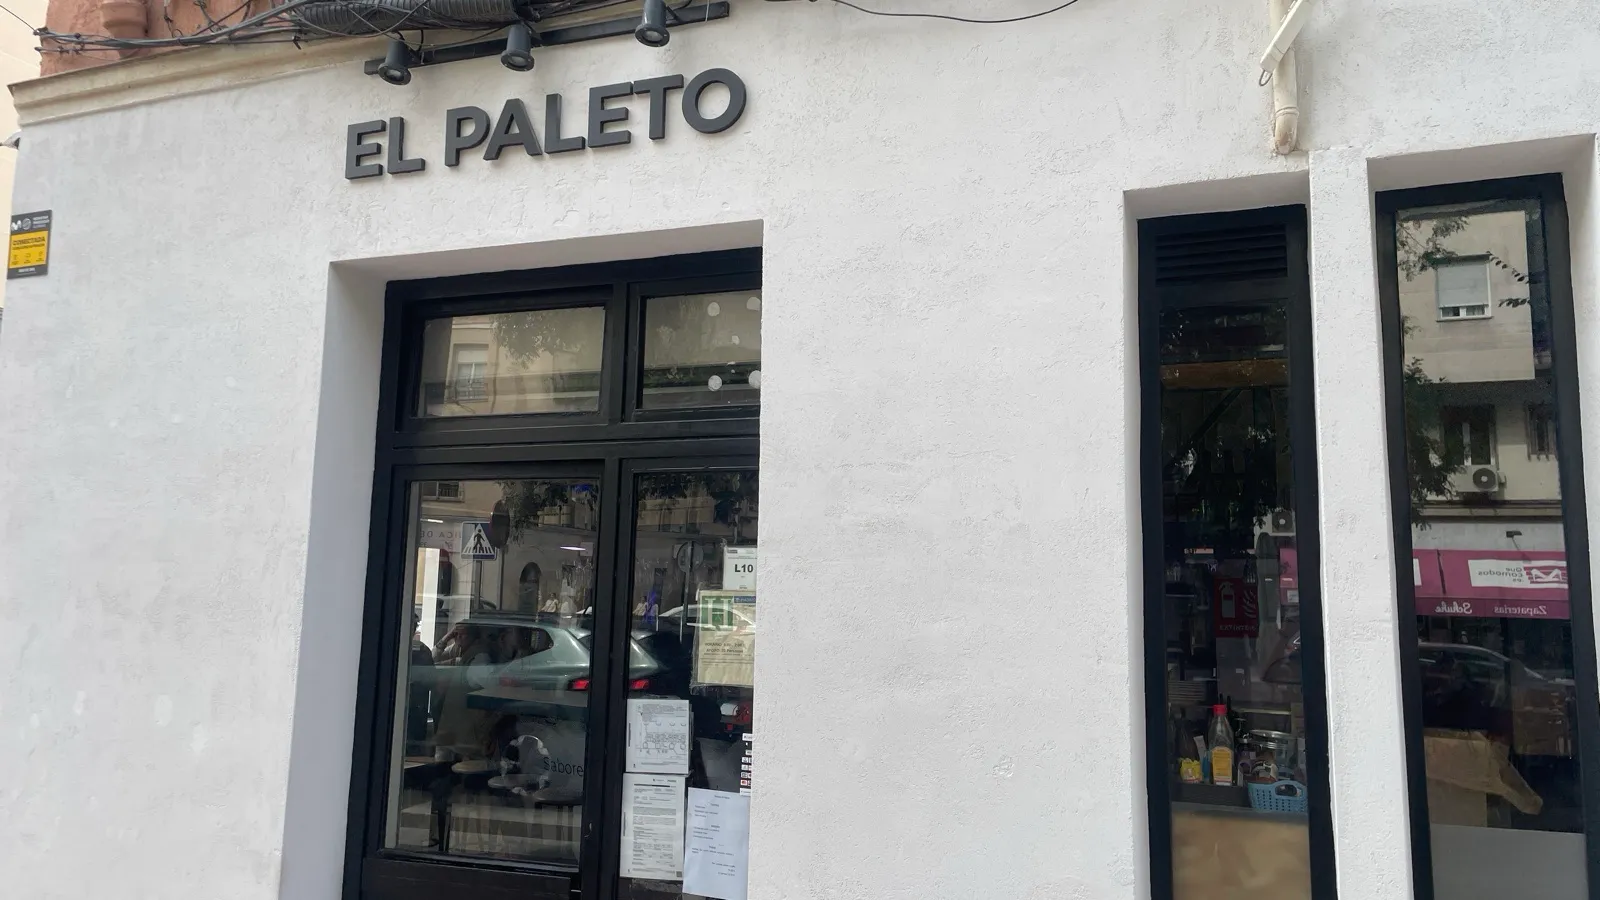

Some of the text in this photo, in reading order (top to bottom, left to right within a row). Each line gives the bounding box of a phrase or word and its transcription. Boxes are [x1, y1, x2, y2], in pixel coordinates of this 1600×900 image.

[344, 67, 747, 180] EL PALETO
[734, 563, 754, 573] L10
